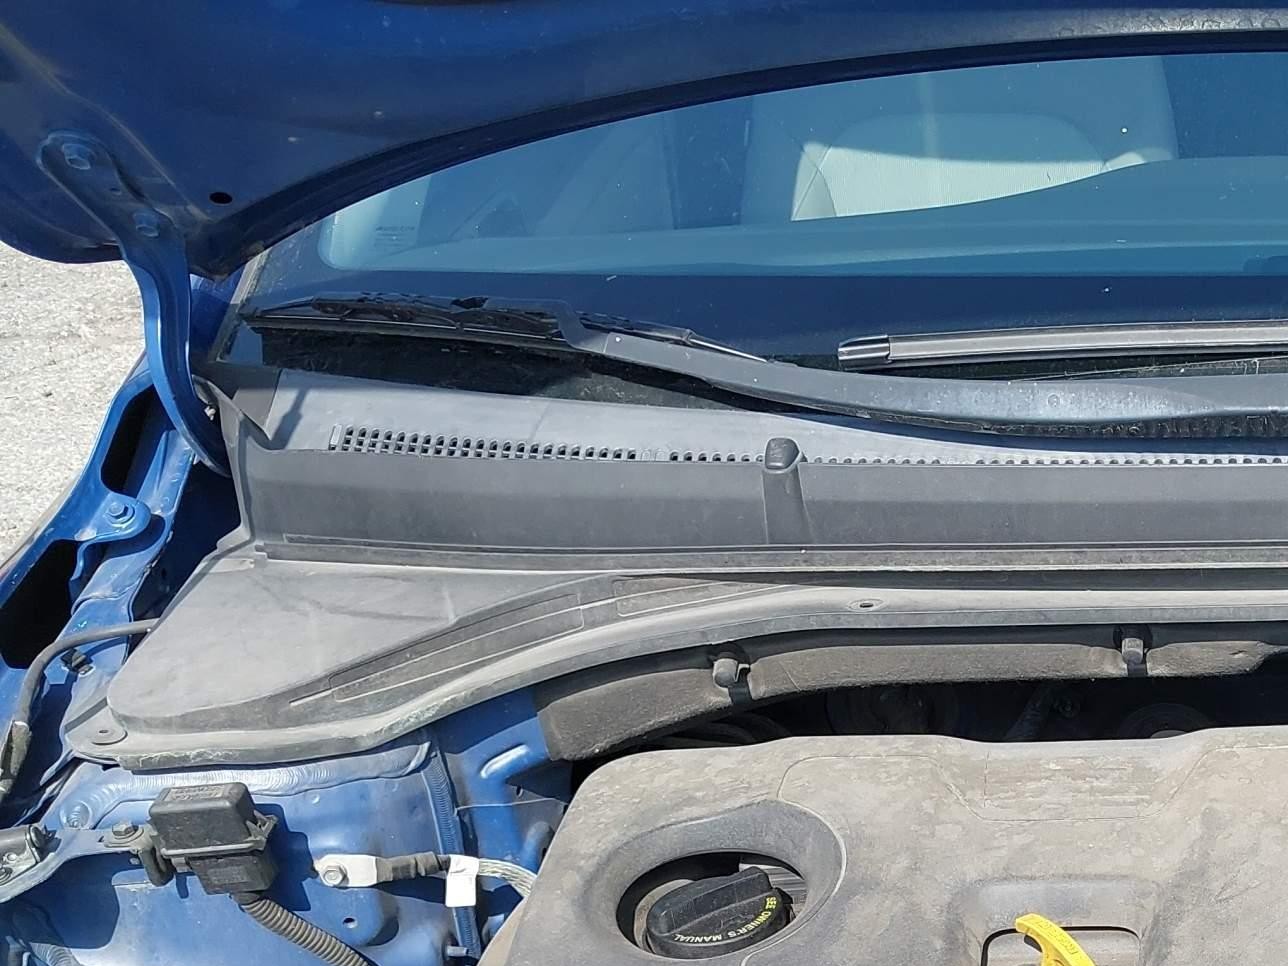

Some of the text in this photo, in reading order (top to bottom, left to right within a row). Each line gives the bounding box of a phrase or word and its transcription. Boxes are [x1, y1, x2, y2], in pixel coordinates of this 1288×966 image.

[673, 895, 777, 944] SEE OWNER'S MANUAL
